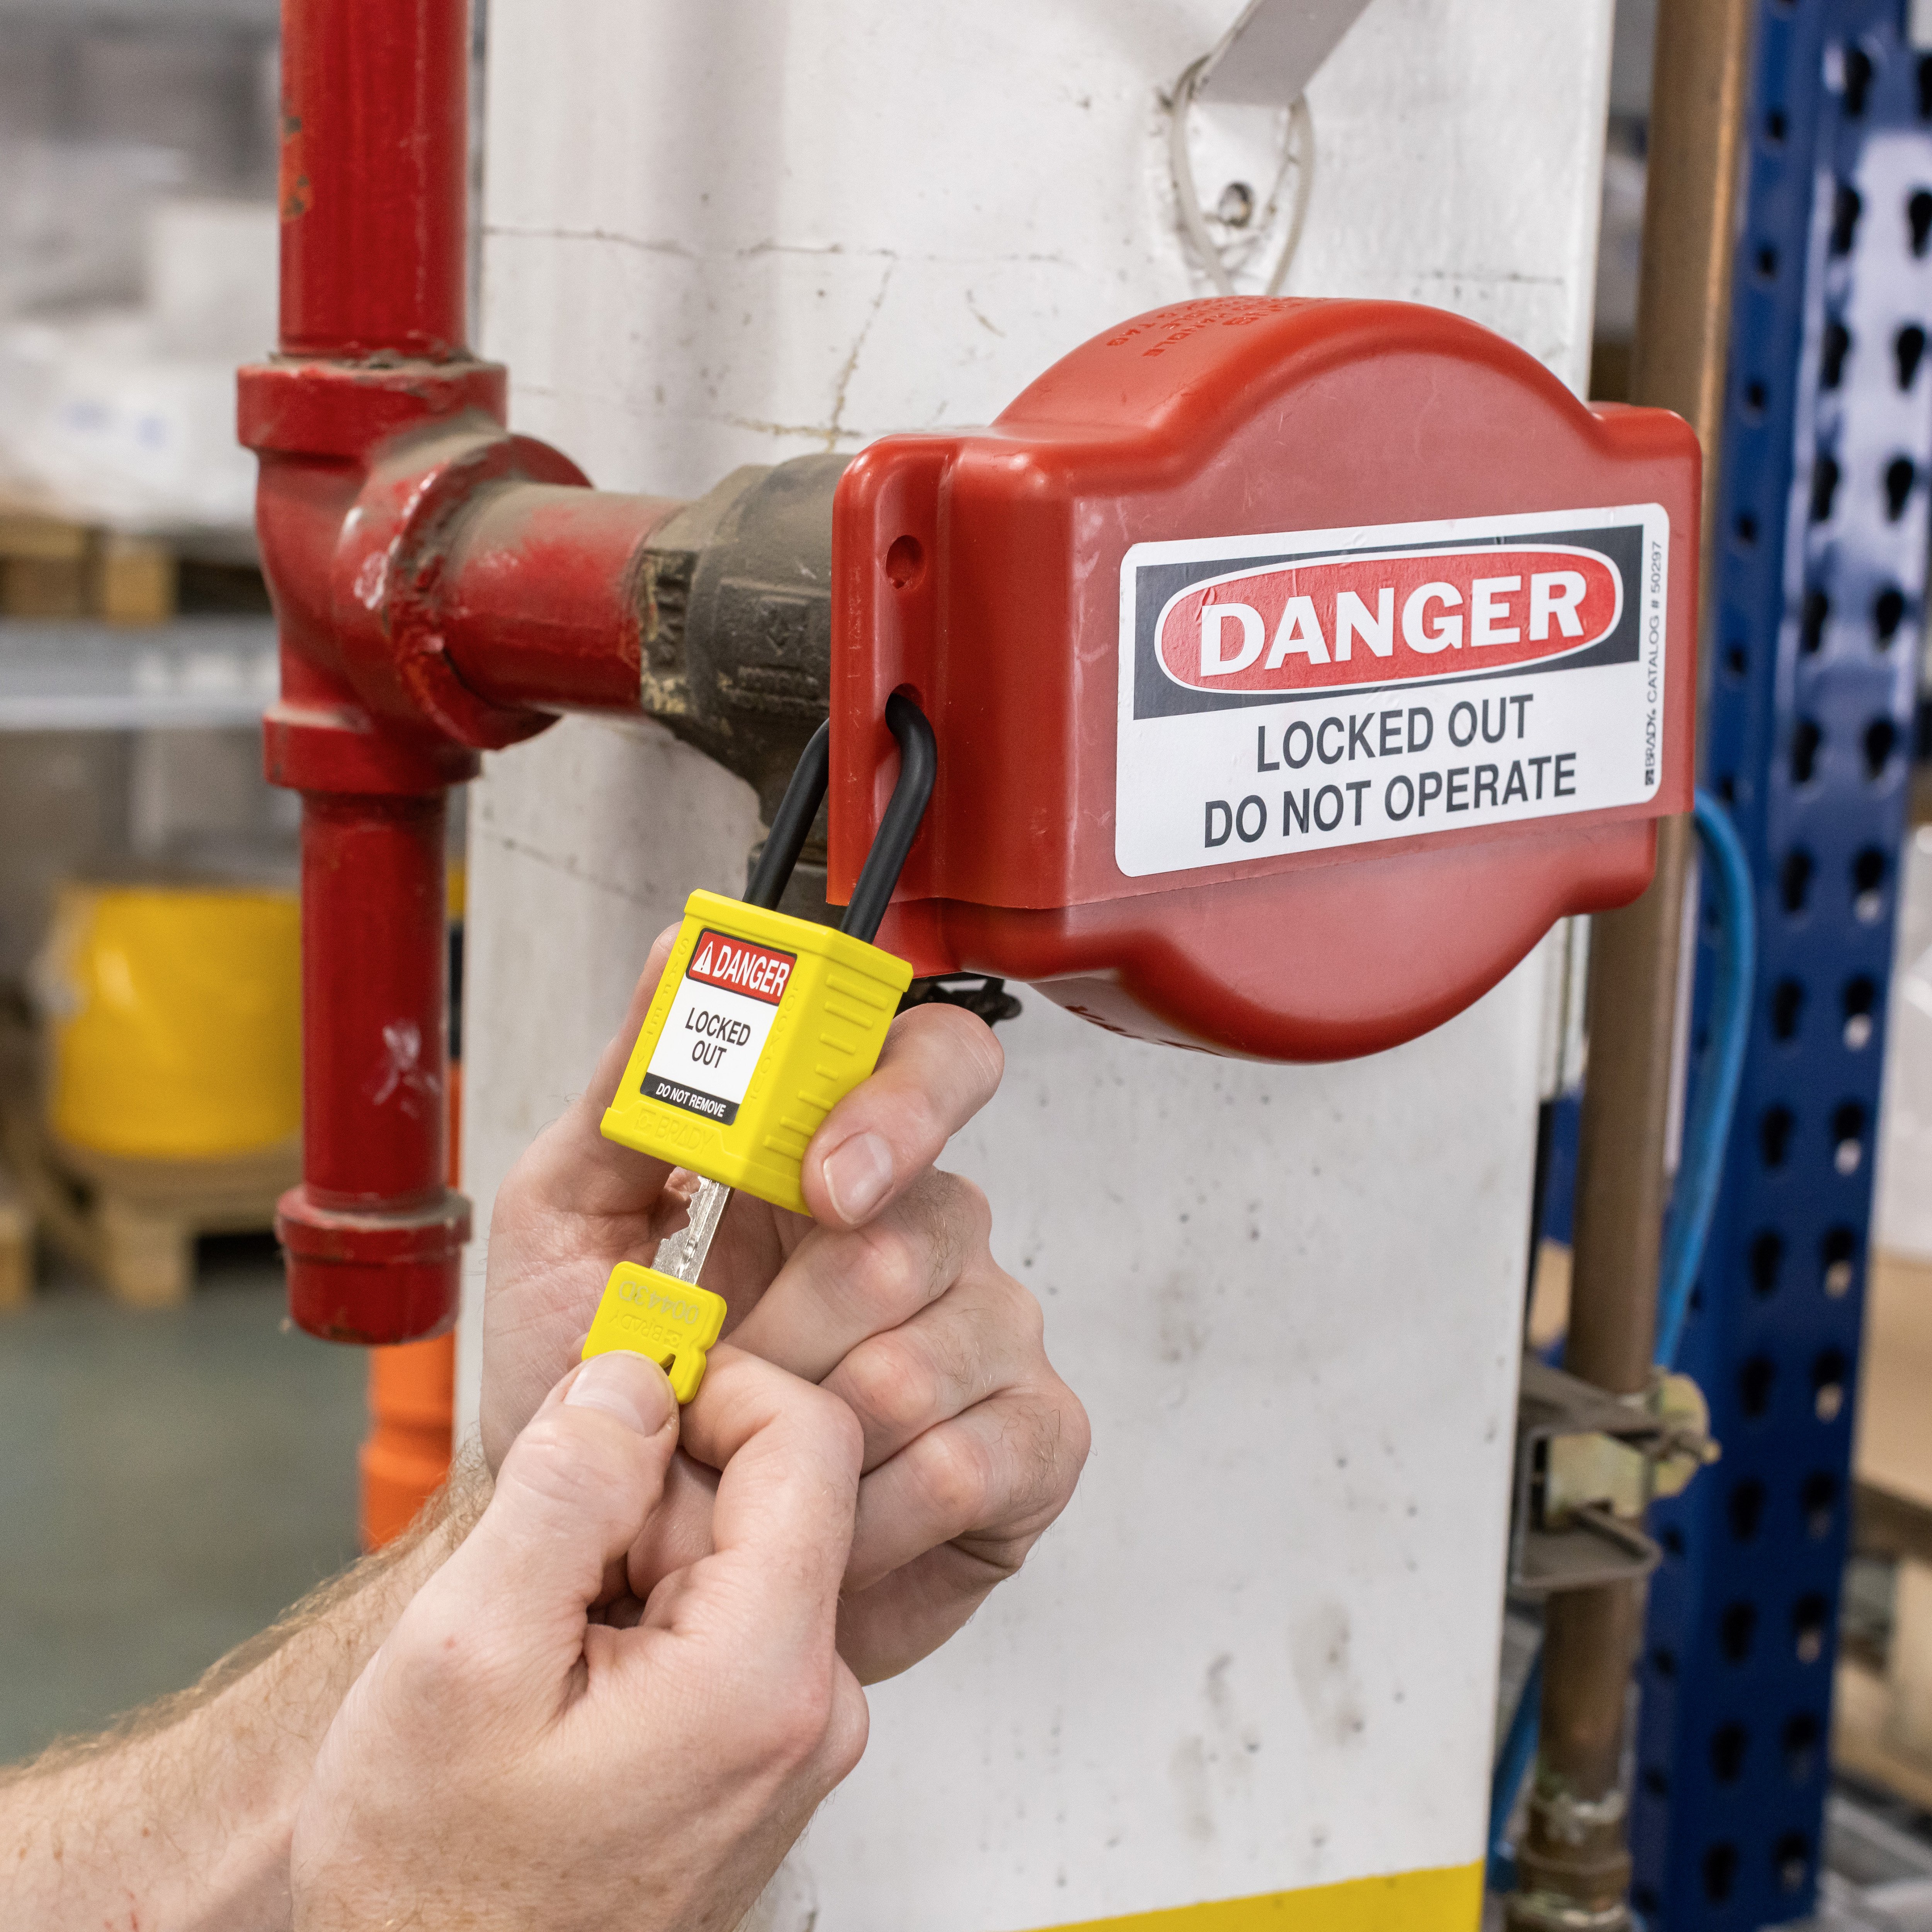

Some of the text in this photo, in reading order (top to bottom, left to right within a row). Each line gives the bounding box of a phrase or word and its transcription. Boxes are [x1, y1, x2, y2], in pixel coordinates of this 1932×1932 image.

[1650, 541, 1662, 593] 50297
[1199, 571, 1586, 677] DANGER
[1651, 600, 1659, 609] #
[1647, 615, 1659, 703] CATALOG
[1257, 694, 1534, 773] LOCKED OUT
[1204, 752, 1577, 849] DO NOT OPERATE
[712, 945, 790, 997] DANGER
[685, 1007, 751, 1046] LOCKED
[692, 1040, 727, 1068] OUT
[655, 1082, 726, 1117] DO NOT REMOVE
[655, 1115, 714, 1155] BRADY
